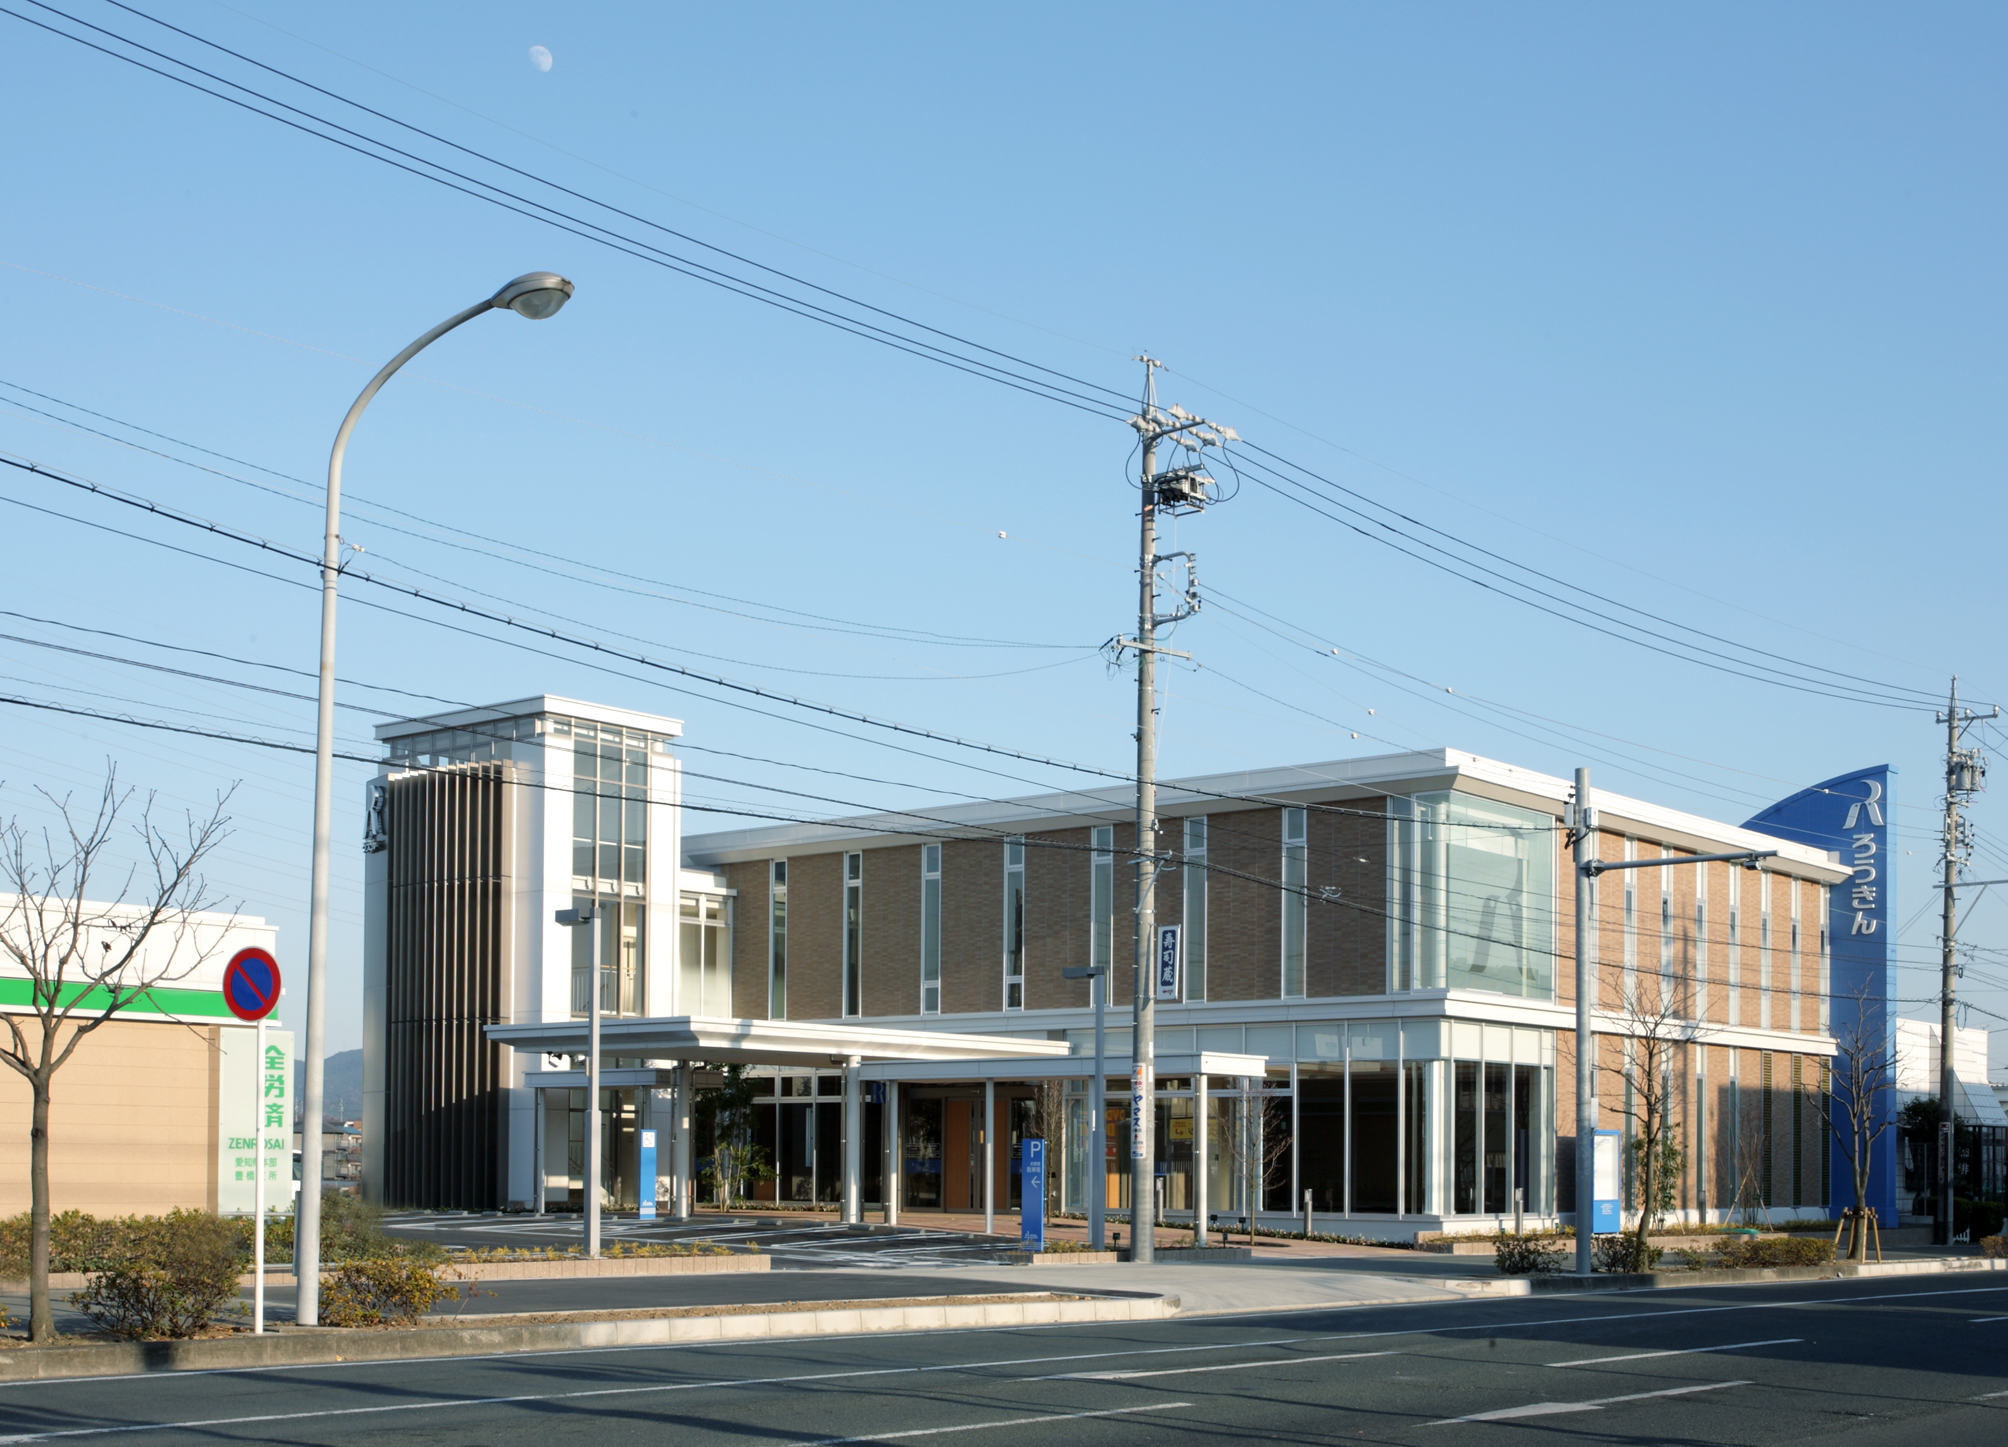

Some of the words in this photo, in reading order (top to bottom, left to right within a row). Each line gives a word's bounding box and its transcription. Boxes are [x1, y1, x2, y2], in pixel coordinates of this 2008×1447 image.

[1851, 833, 1877, 935] ろうきん
[1161, 931, 1175, 983] 寿司蔵
[1132, 1093, 1144, 1128] ヤマス
[1030, 1140, 1042, 1158] P
[235, 1170, 277, 1181] 豊橋所
